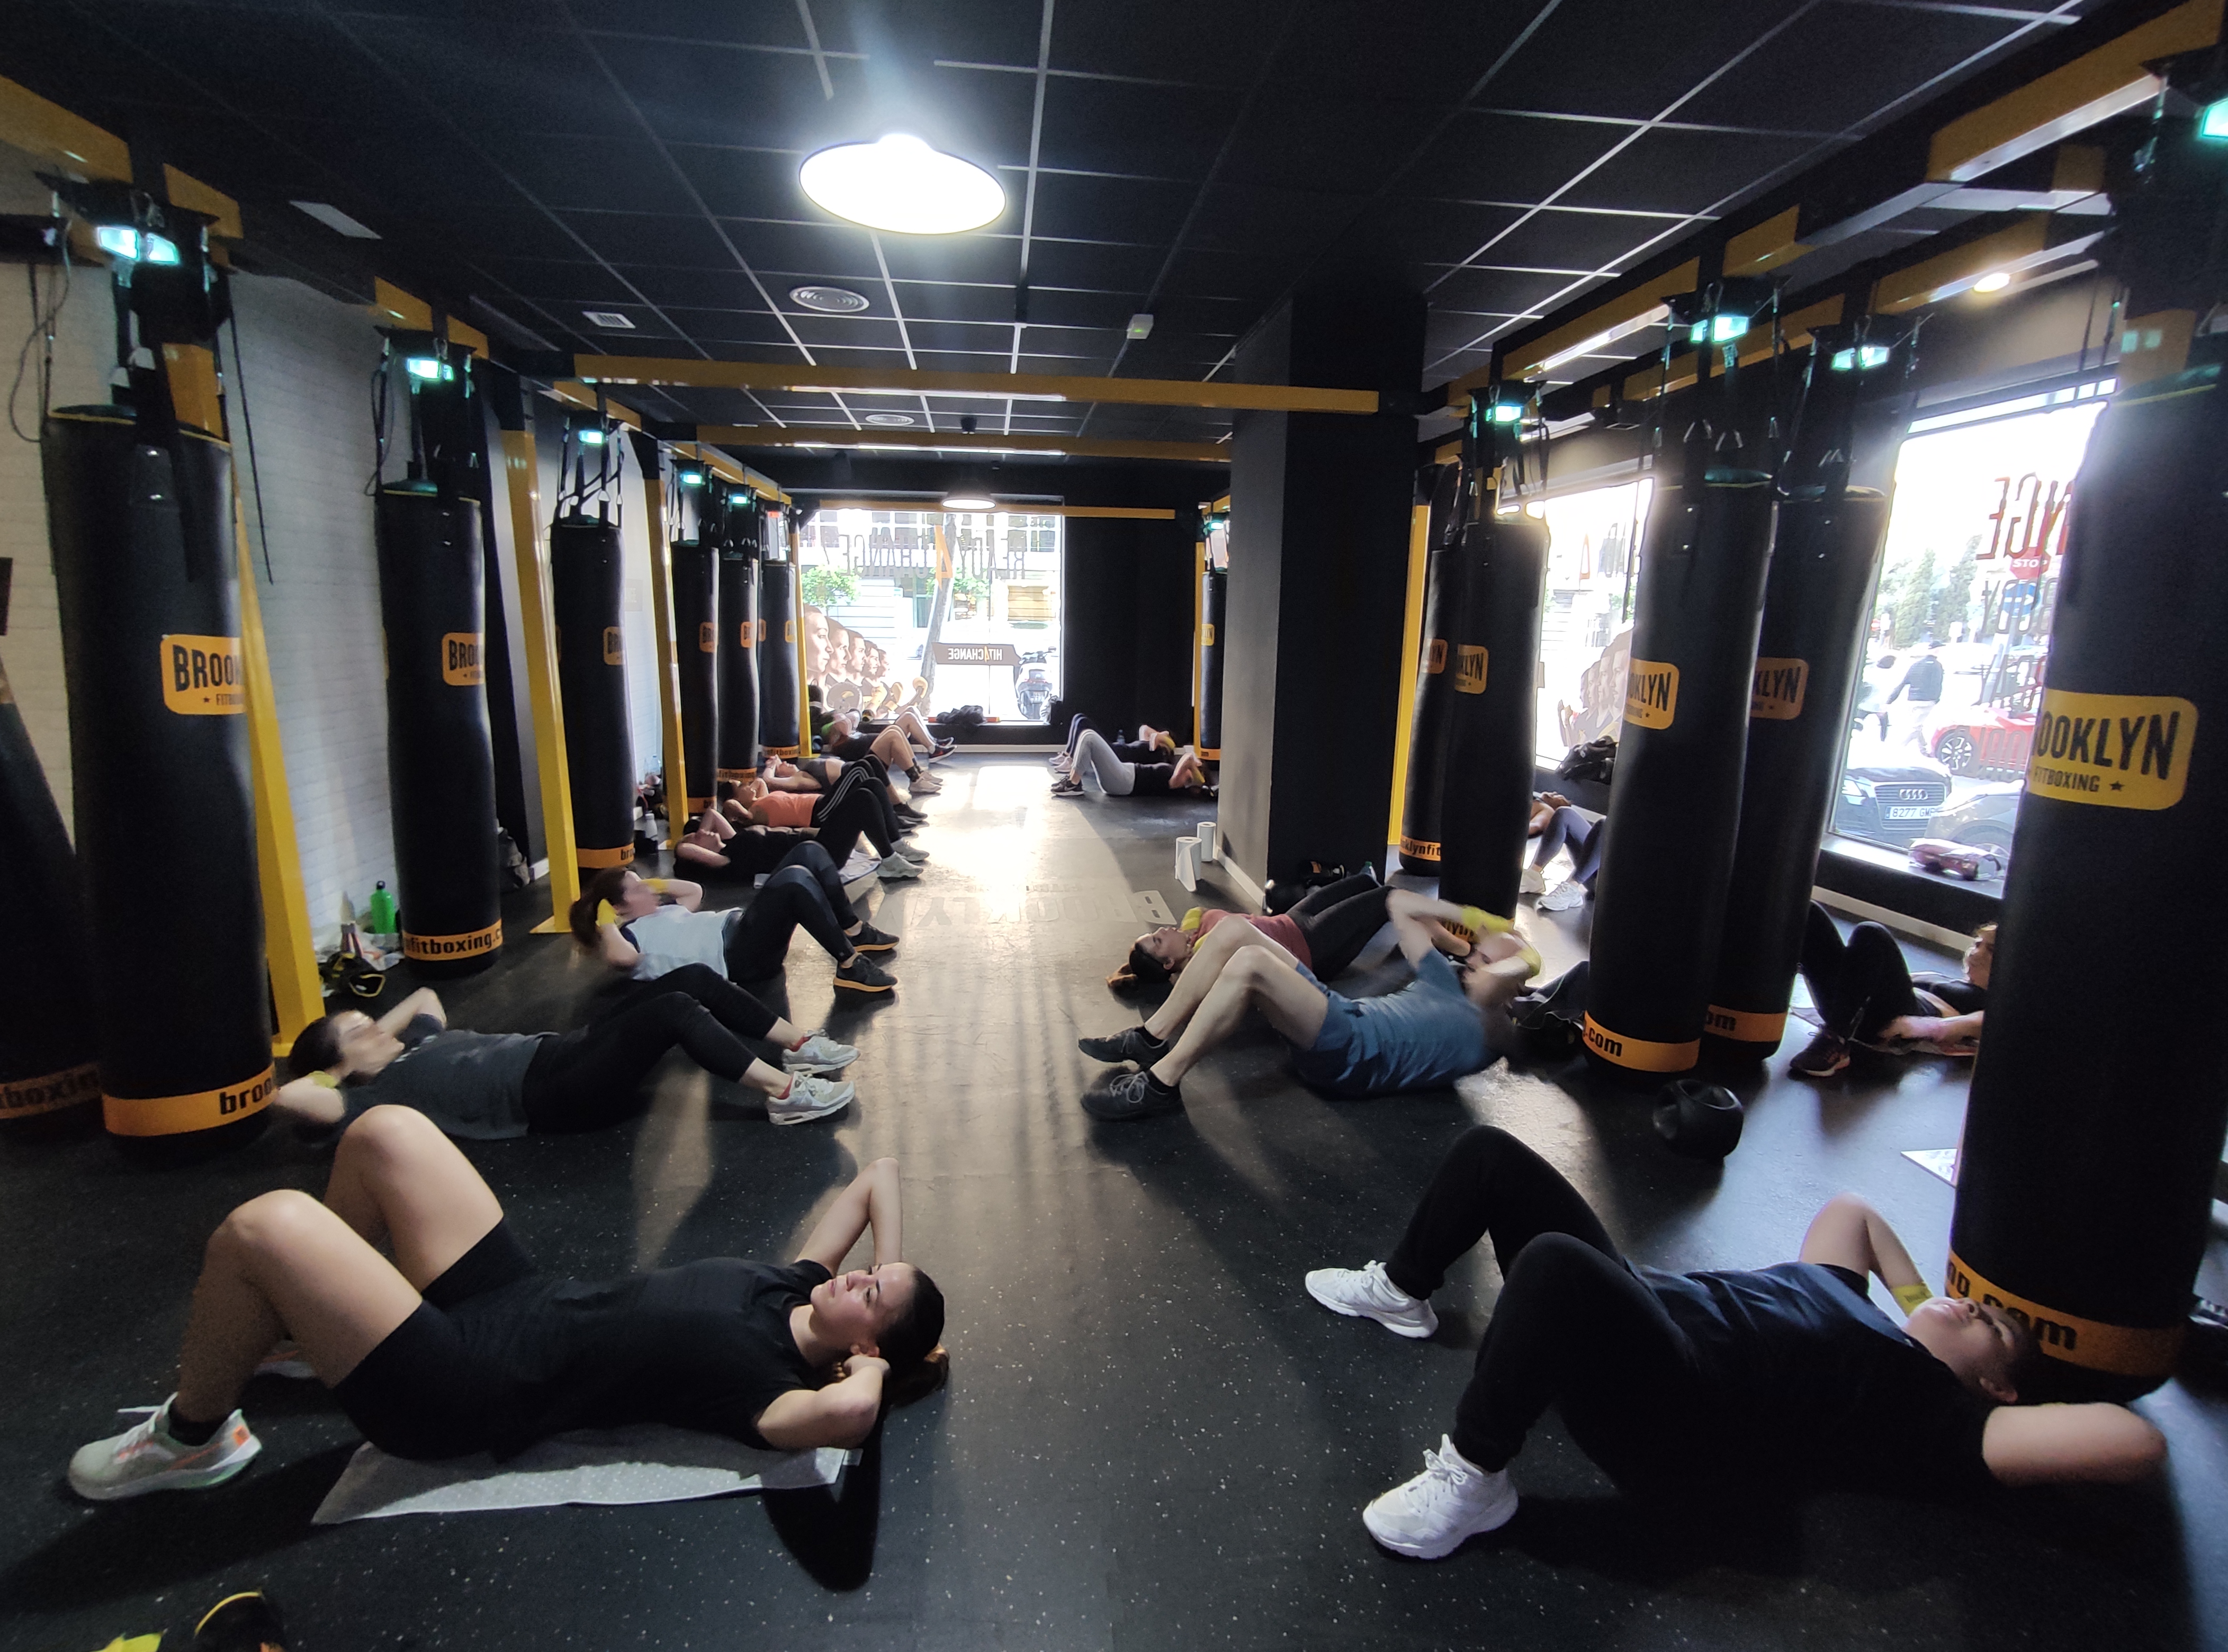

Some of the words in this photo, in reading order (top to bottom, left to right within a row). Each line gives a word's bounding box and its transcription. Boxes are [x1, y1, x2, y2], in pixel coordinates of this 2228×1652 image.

[2012, 559, 2048, 568] STOP
[2032, 711, 2181, 780] OOKLYN
[2034, 766, 2100, 792] FITBOXING
[1892, 808, 1918, 818] 8277
